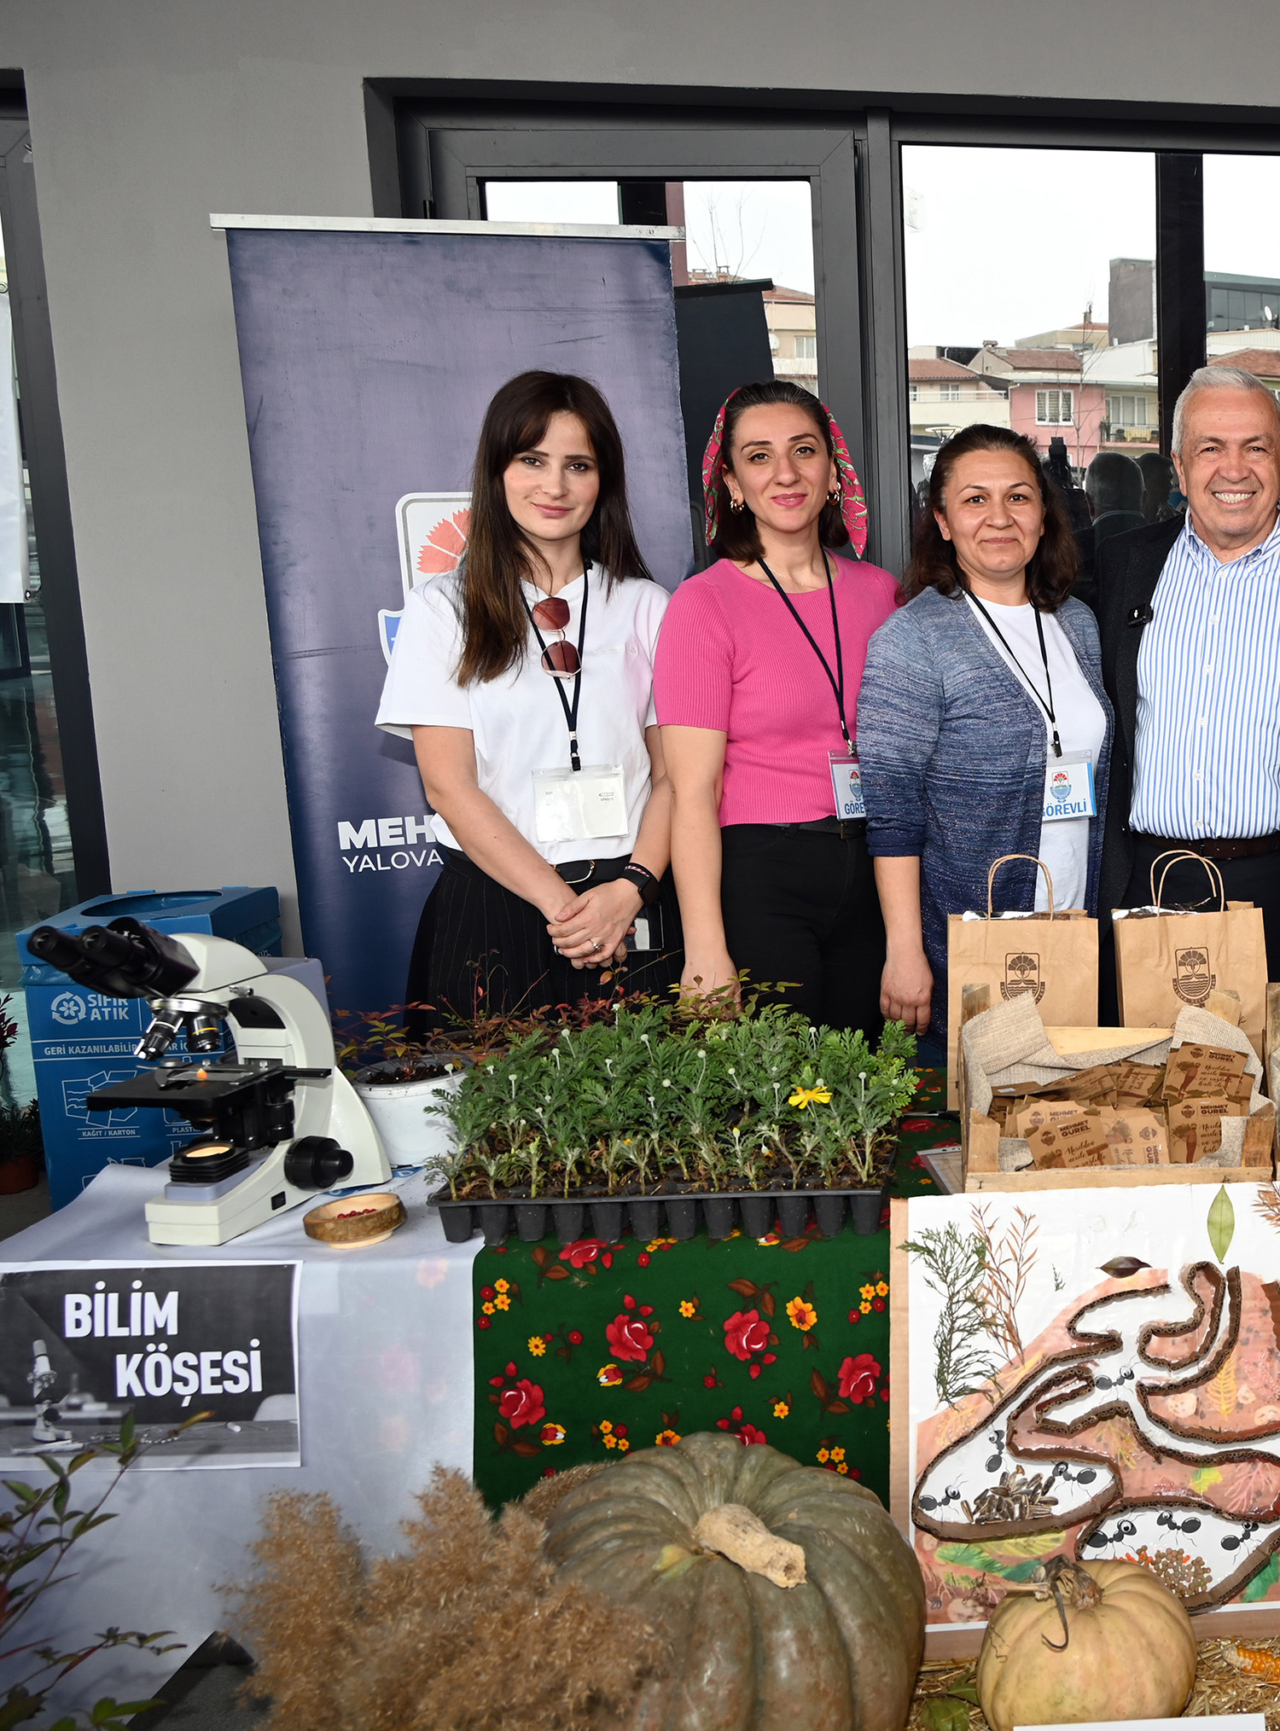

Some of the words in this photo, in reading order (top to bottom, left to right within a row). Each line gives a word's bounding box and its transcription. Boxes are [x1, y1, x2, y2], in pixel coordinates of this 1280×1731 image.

[844, 800, 866, 815] GÖRE
[1043, 798, 1087, 817] ÖREVLİ
[338, 815, 437, 850] MEH
[342, 849, 444, 873] YALOVA
[88, 993, 129, 1007] SIFIR
[90, 1007, 129, 1021] ATIK
[44, 1044, 66, 1056] GERİ
[82, 1129, 102, 1137] KAĞIT
[64, 1279, 179, 1338] BİLİM
[116, 1338, 262, 1407] KÖŞESİ
